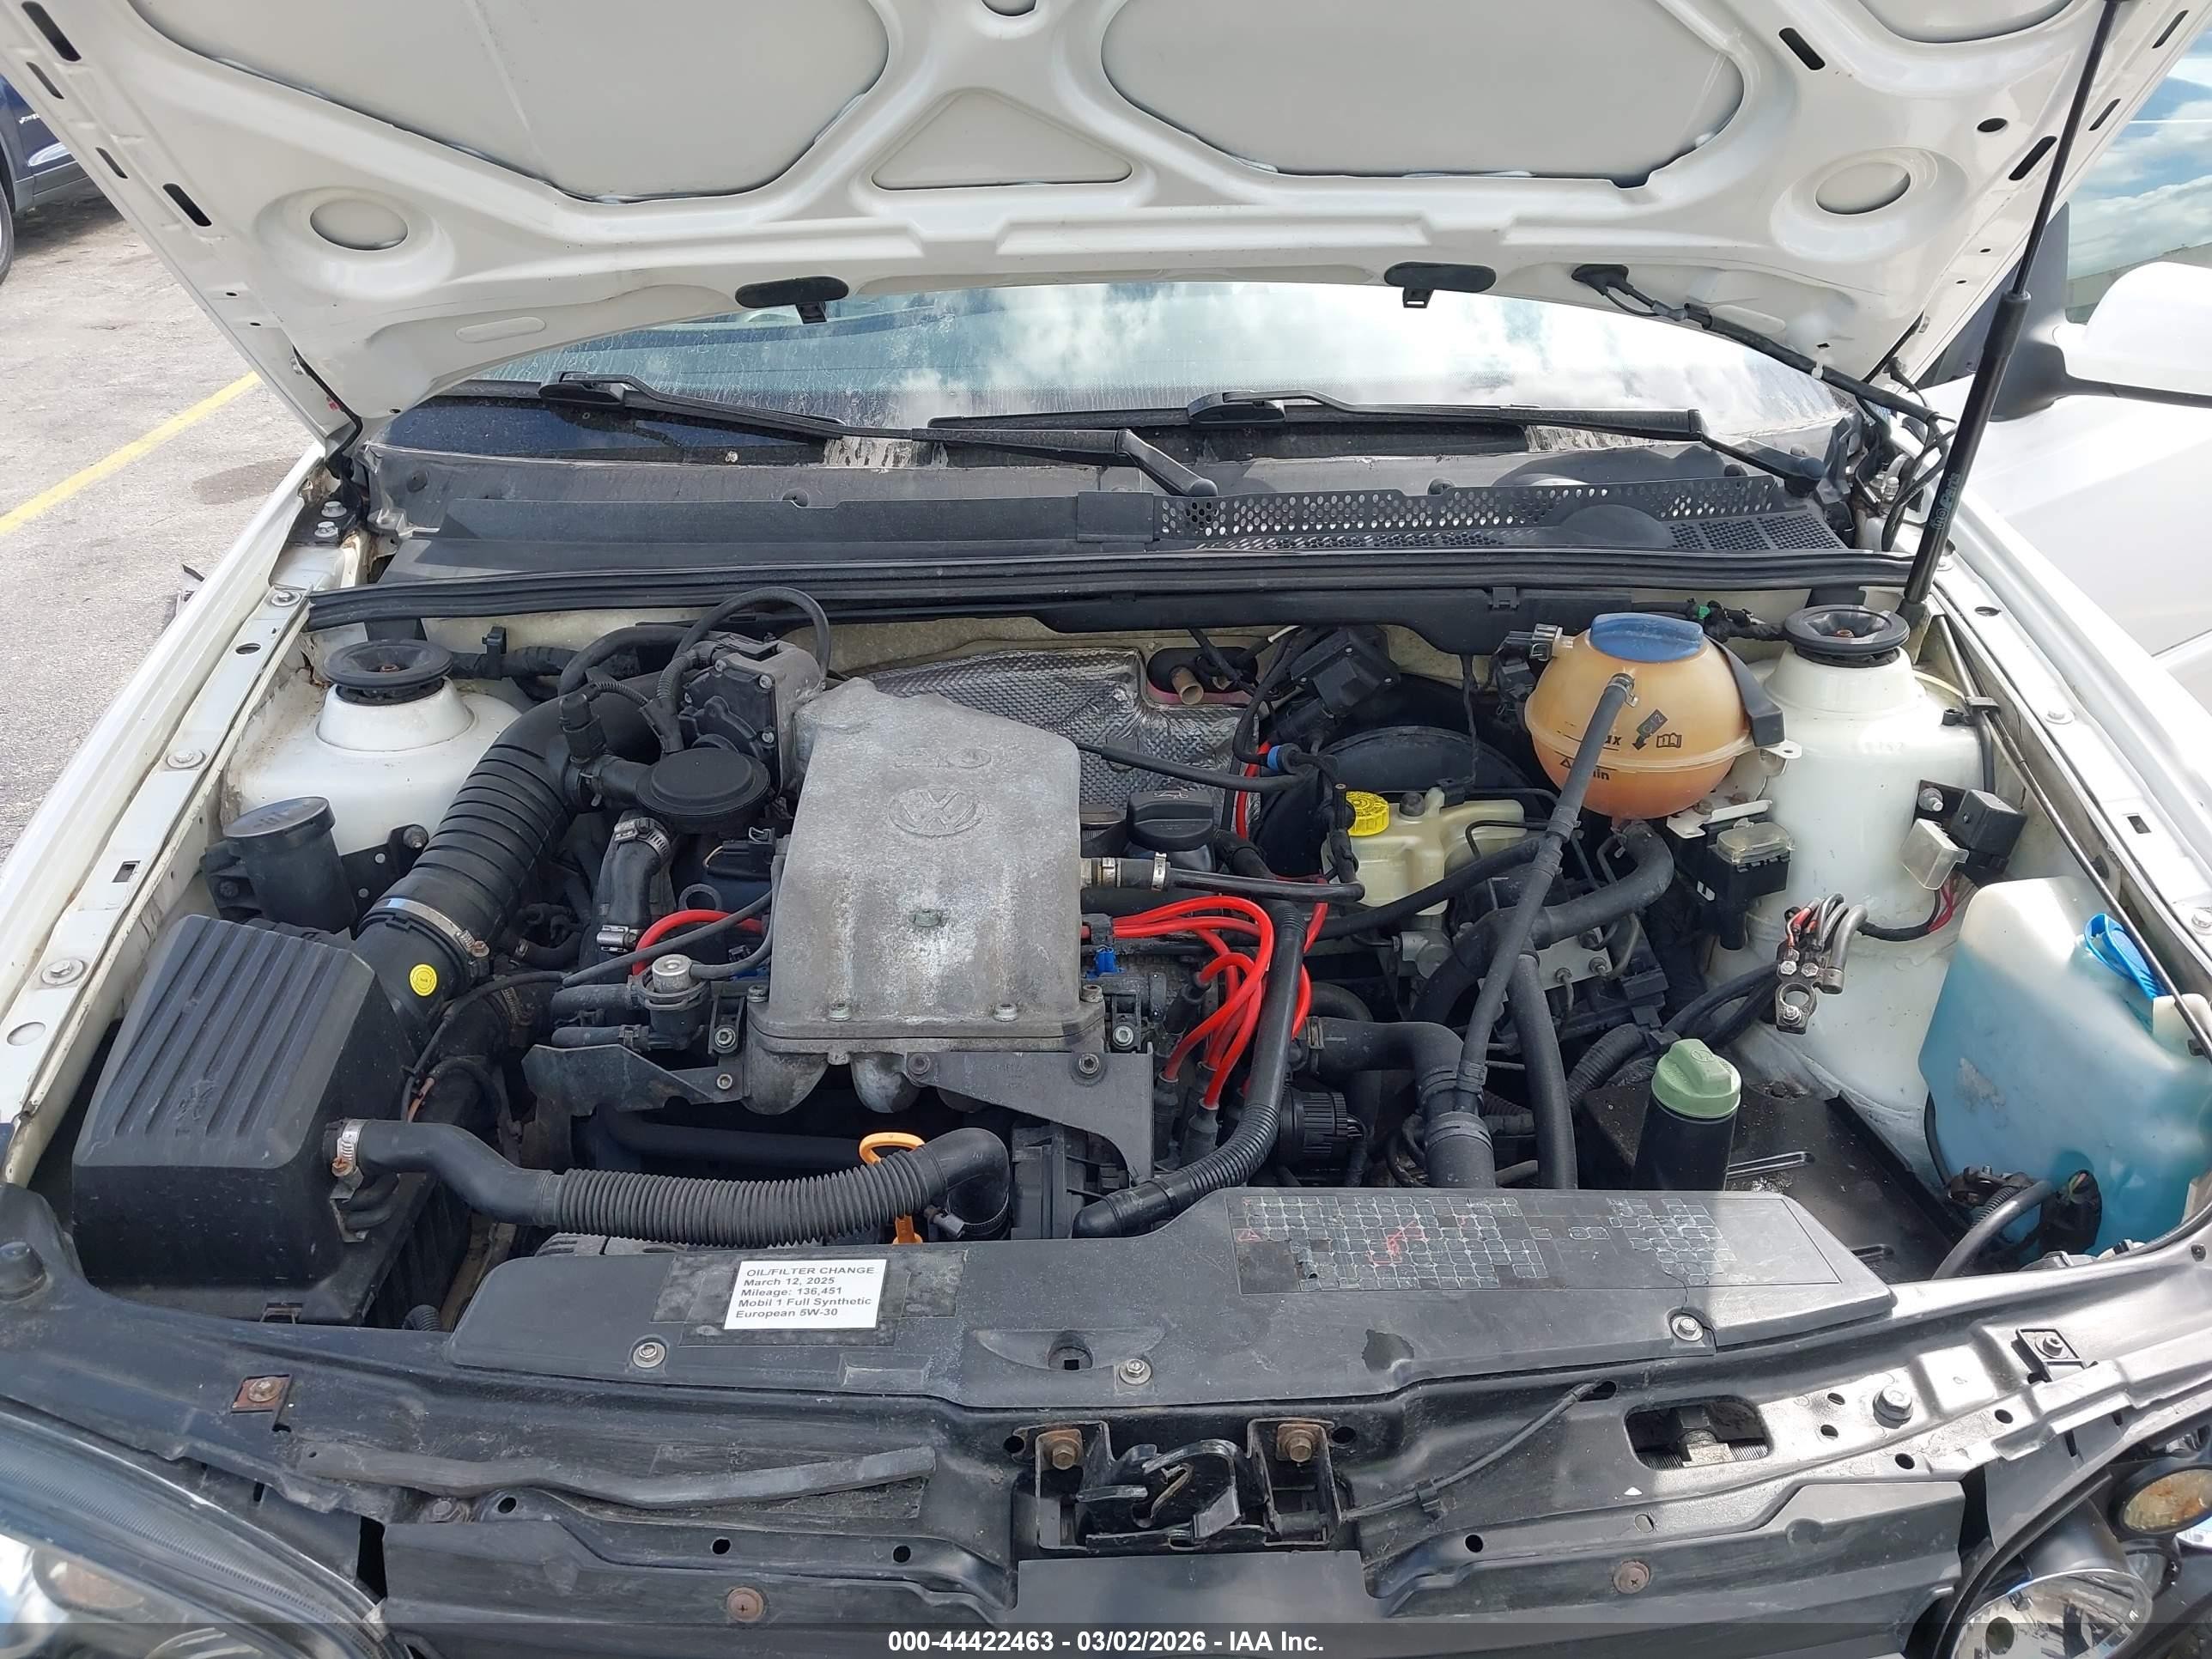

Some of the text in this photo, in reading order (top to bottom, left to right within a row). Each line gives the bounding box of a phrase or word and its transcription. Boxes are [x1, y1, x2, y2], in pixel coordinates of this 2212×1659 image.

[1604, 735, 1621, 745] ax
[1593, 769, 1610, 781] in
[746, 1267, 816, 1277] OIL/FILTER
[744, 1276, 835, 1286] March 12, 2025
[741, 1286, 842, 1297] Mileage: 136,451
[738, 1298, 773, 1308] Mobil
[787, 1297, 810, 1306] Full
[813, 1297, 872, 1307] Synthetic
[736, 1308, 838, 1319] European 5W-30
